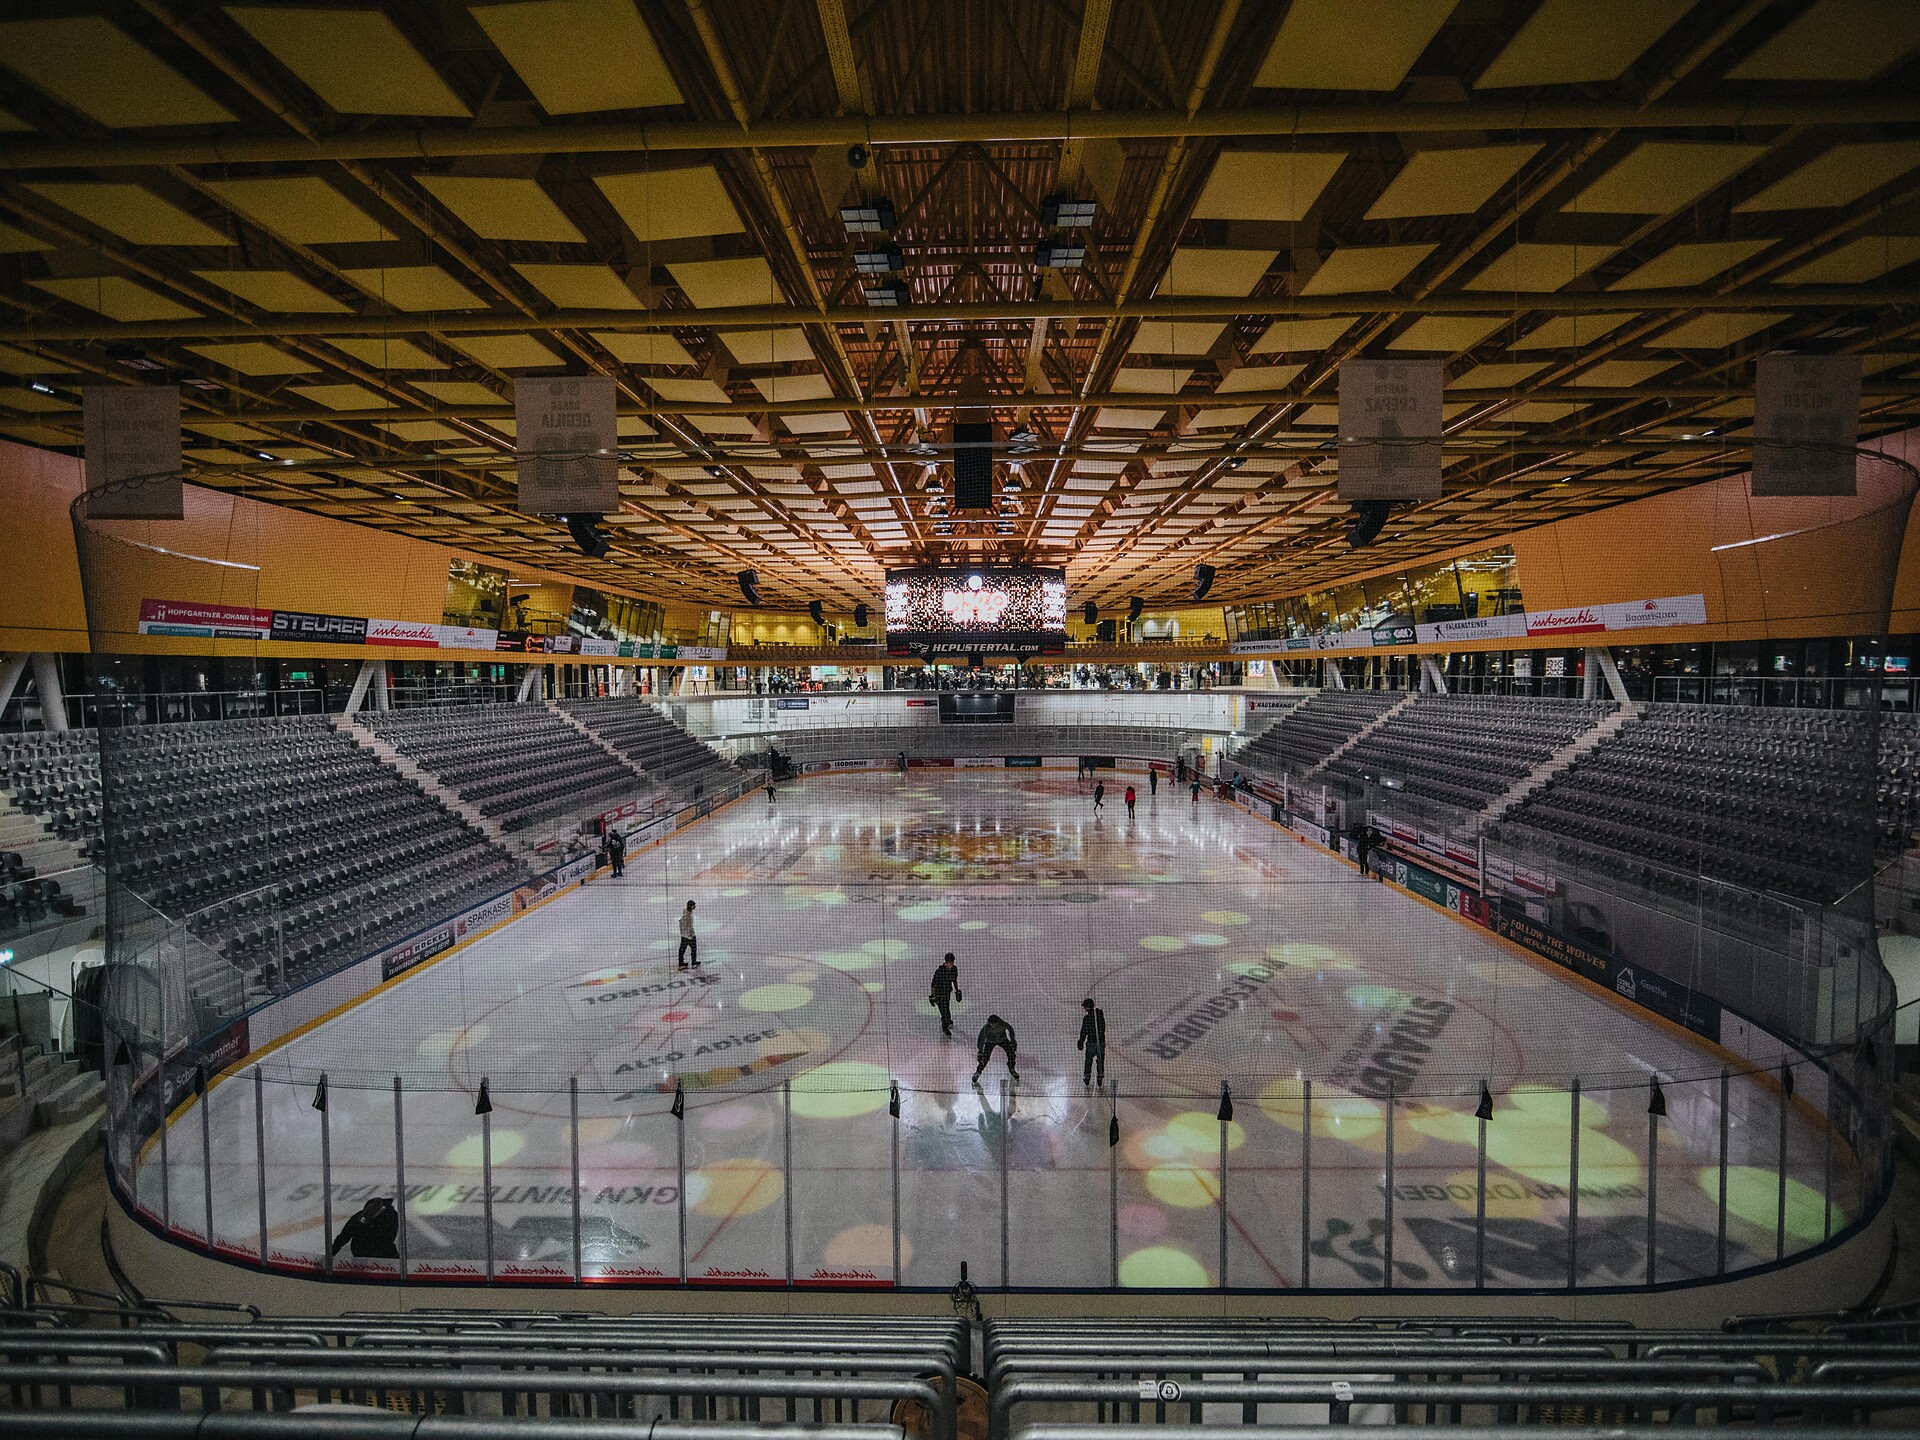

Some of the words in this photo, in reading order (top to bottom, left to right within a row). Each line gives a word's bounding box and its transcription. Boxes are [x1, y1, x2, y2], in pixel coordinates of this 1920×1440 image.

[168, 608, 220, 618] HOPFGARTNER
[1532, 609, 1599, 627] intercable
[1626, 611, 1678, 622] Buonristoro
[273, 614, 366, 634] STEURER
[373, 624, 435, 640] intercable
[1446, 620, 1488, 630] FALKENSTEINER
[467, 898, 511, 926] SPARKASSE
[392, 949, 410, 963] PRO
[414, 931, 448, 952] HOCKEY
[1511, 919, 1544, 940] FOLLOW
[1547, 936, 1564, 950] THE
[1566, 944, 1606, 970] WOLVES
[1523, 936, 1574, 965] HCPUSTERTAL
[1640, 979, 1667, 998] Goethe
[614, 1052, 684, 1075] ALTO
[694, 1028, 781, 1056] ADIGE
[286, 1183, 443, 1204] METALS
[453, 1184, 586, 1205] SINTER
[596, 1185, 682, 1206] GKN
[1374, 1184, 1568, 1201] HYDROGEN
